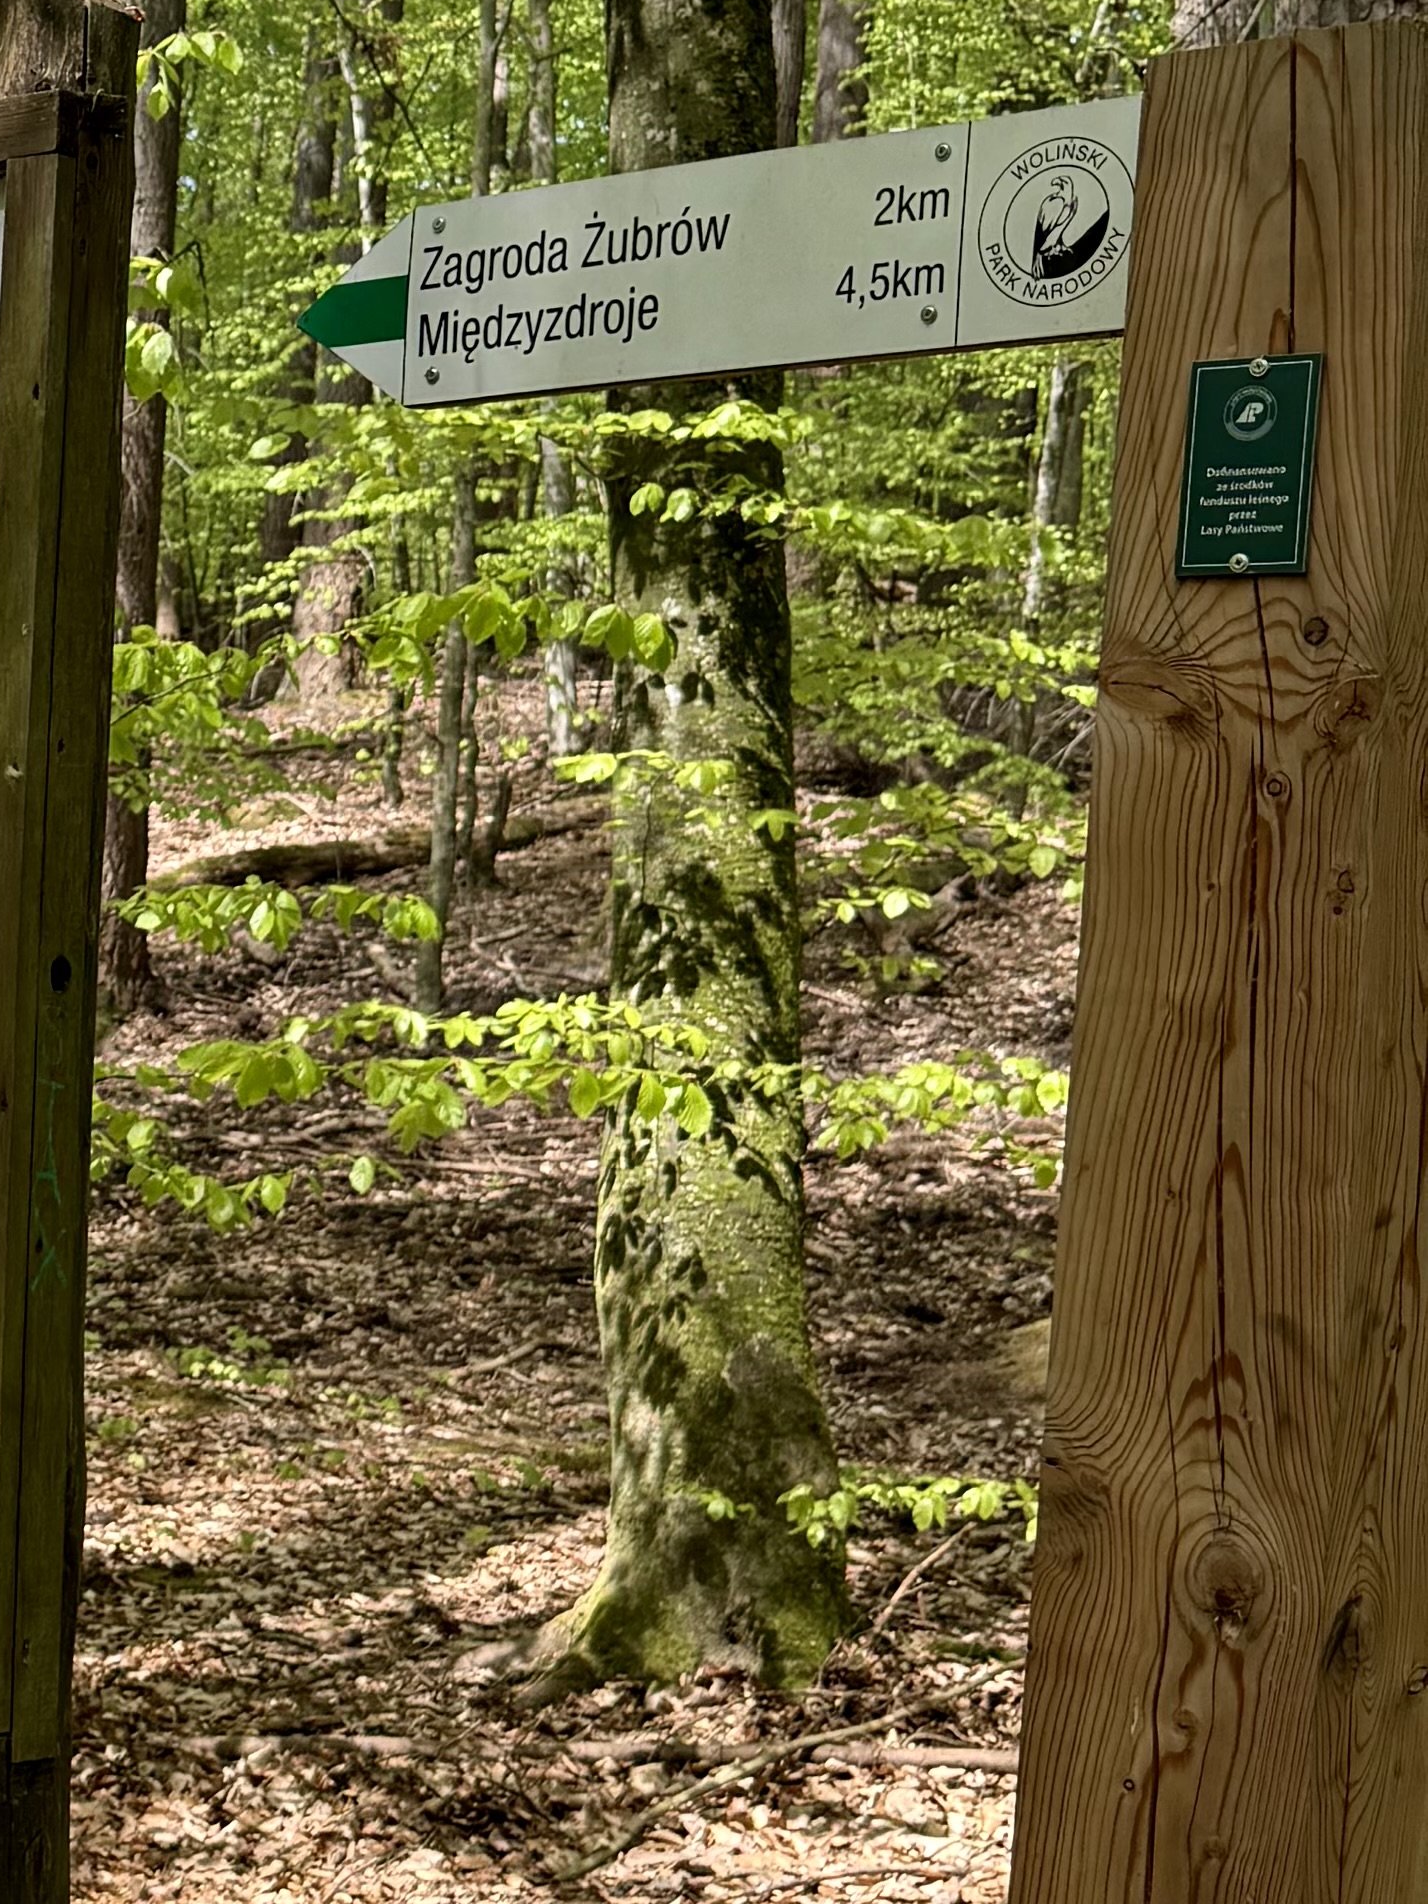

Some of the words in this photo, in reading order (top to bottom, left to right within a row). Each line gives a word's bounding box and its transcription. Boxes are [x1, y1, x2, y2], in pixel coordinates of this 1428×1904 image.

[1011, 138, 1108, 180] WOLIŃSKI
[874, 185, 950, 226] 2km
[420, 230, 568, 294] Zagroda
[581, 207, 730, 268] Żubrów
[986, 243, 1022, 291] PARK
[1023, 227, 1125, 299] NARODOWY
[836, 260, 944, 309] 4,5km
[418, 287, 658, 363] Międzyzdroje
